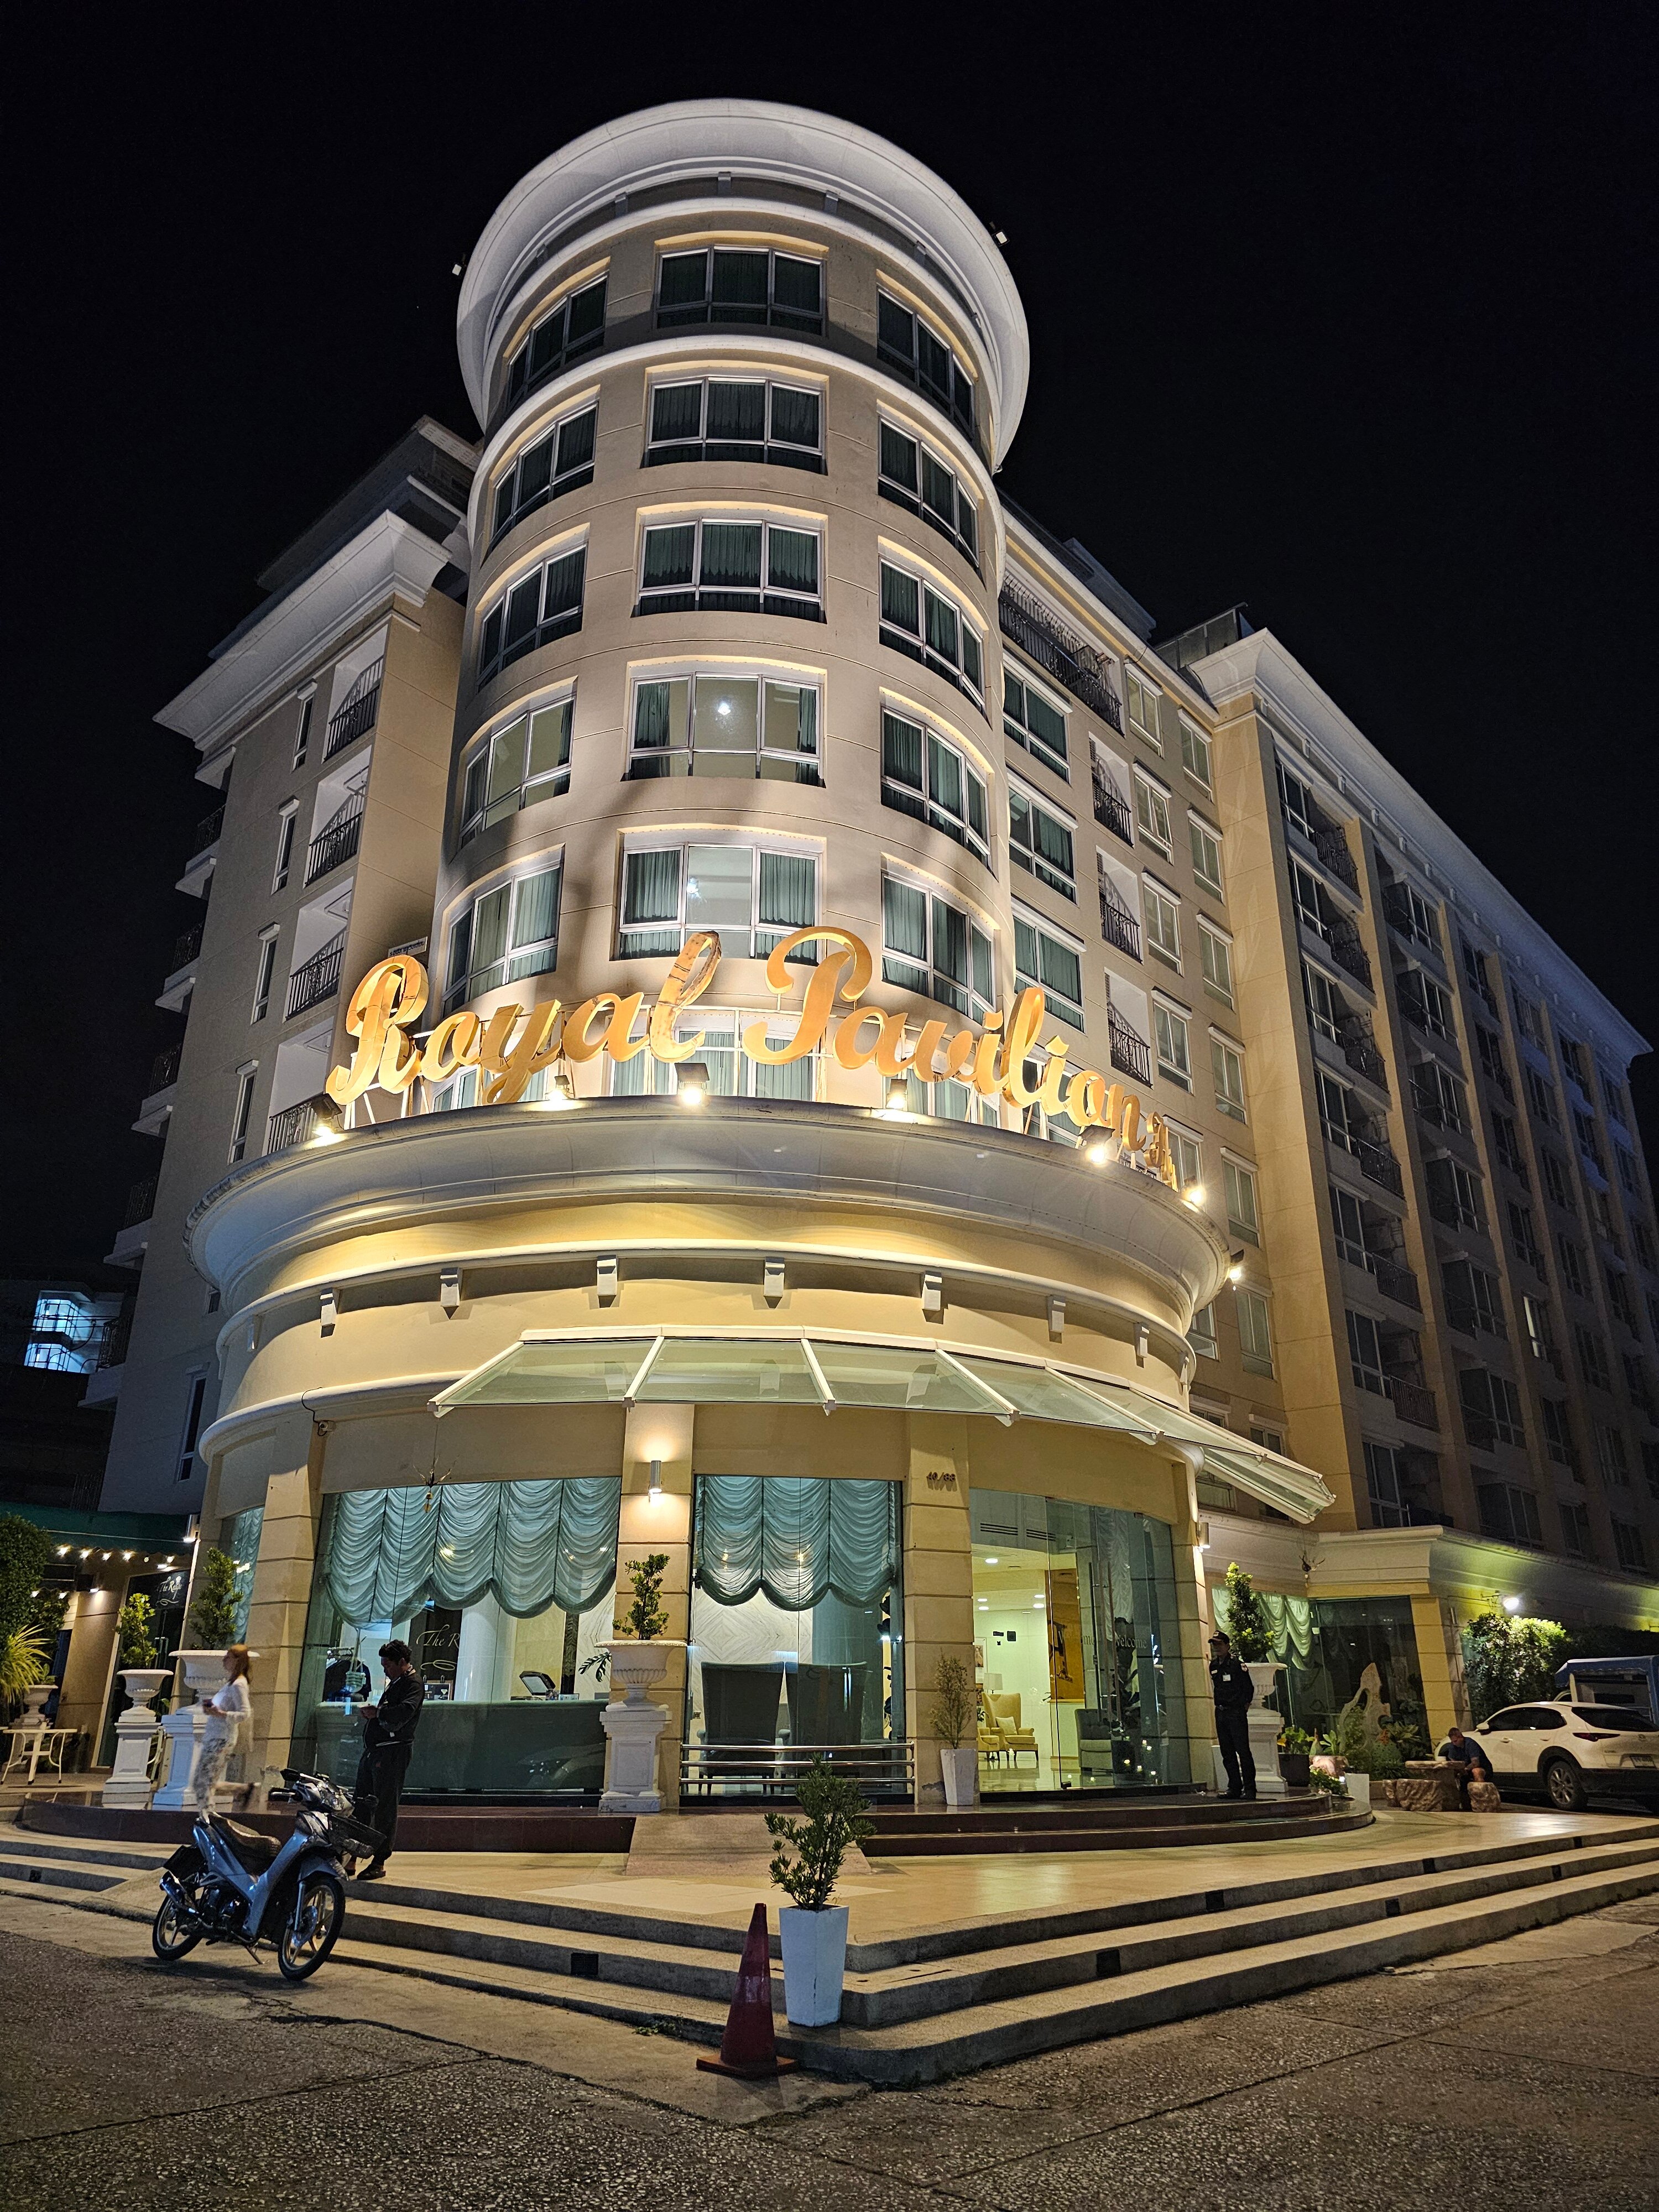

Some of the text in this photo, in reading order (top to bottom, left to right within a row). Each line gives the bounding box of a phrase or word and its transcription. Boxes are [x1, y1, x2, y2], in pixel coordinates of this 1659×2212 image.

[326, 926, 1146, 1151] Royal Pavilion
[926, 1472, 956, 1482] 40/88
[416, 1624, 460, 1649] The R
